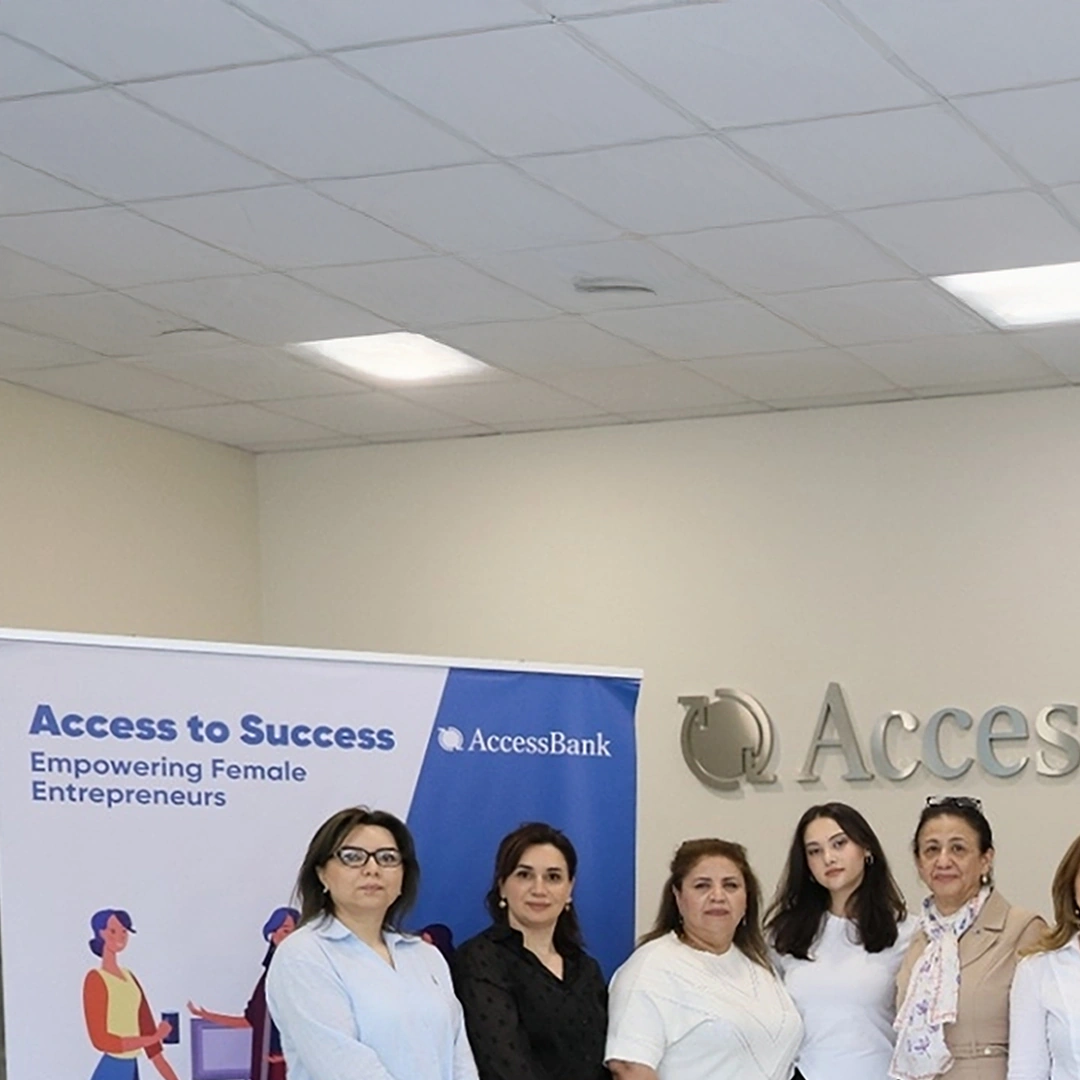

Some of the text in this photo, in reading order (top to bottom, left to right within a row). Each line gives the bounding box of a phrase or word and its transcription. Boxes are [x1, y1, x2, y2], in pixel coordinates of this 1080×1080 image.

[29, 704, 395, 750] Access to Success
[468, 728, 612, 757] AccessBank
[31, 752, 307, 783] Empowering Female
[32, 781, 226, 808] Entrepreneurs
